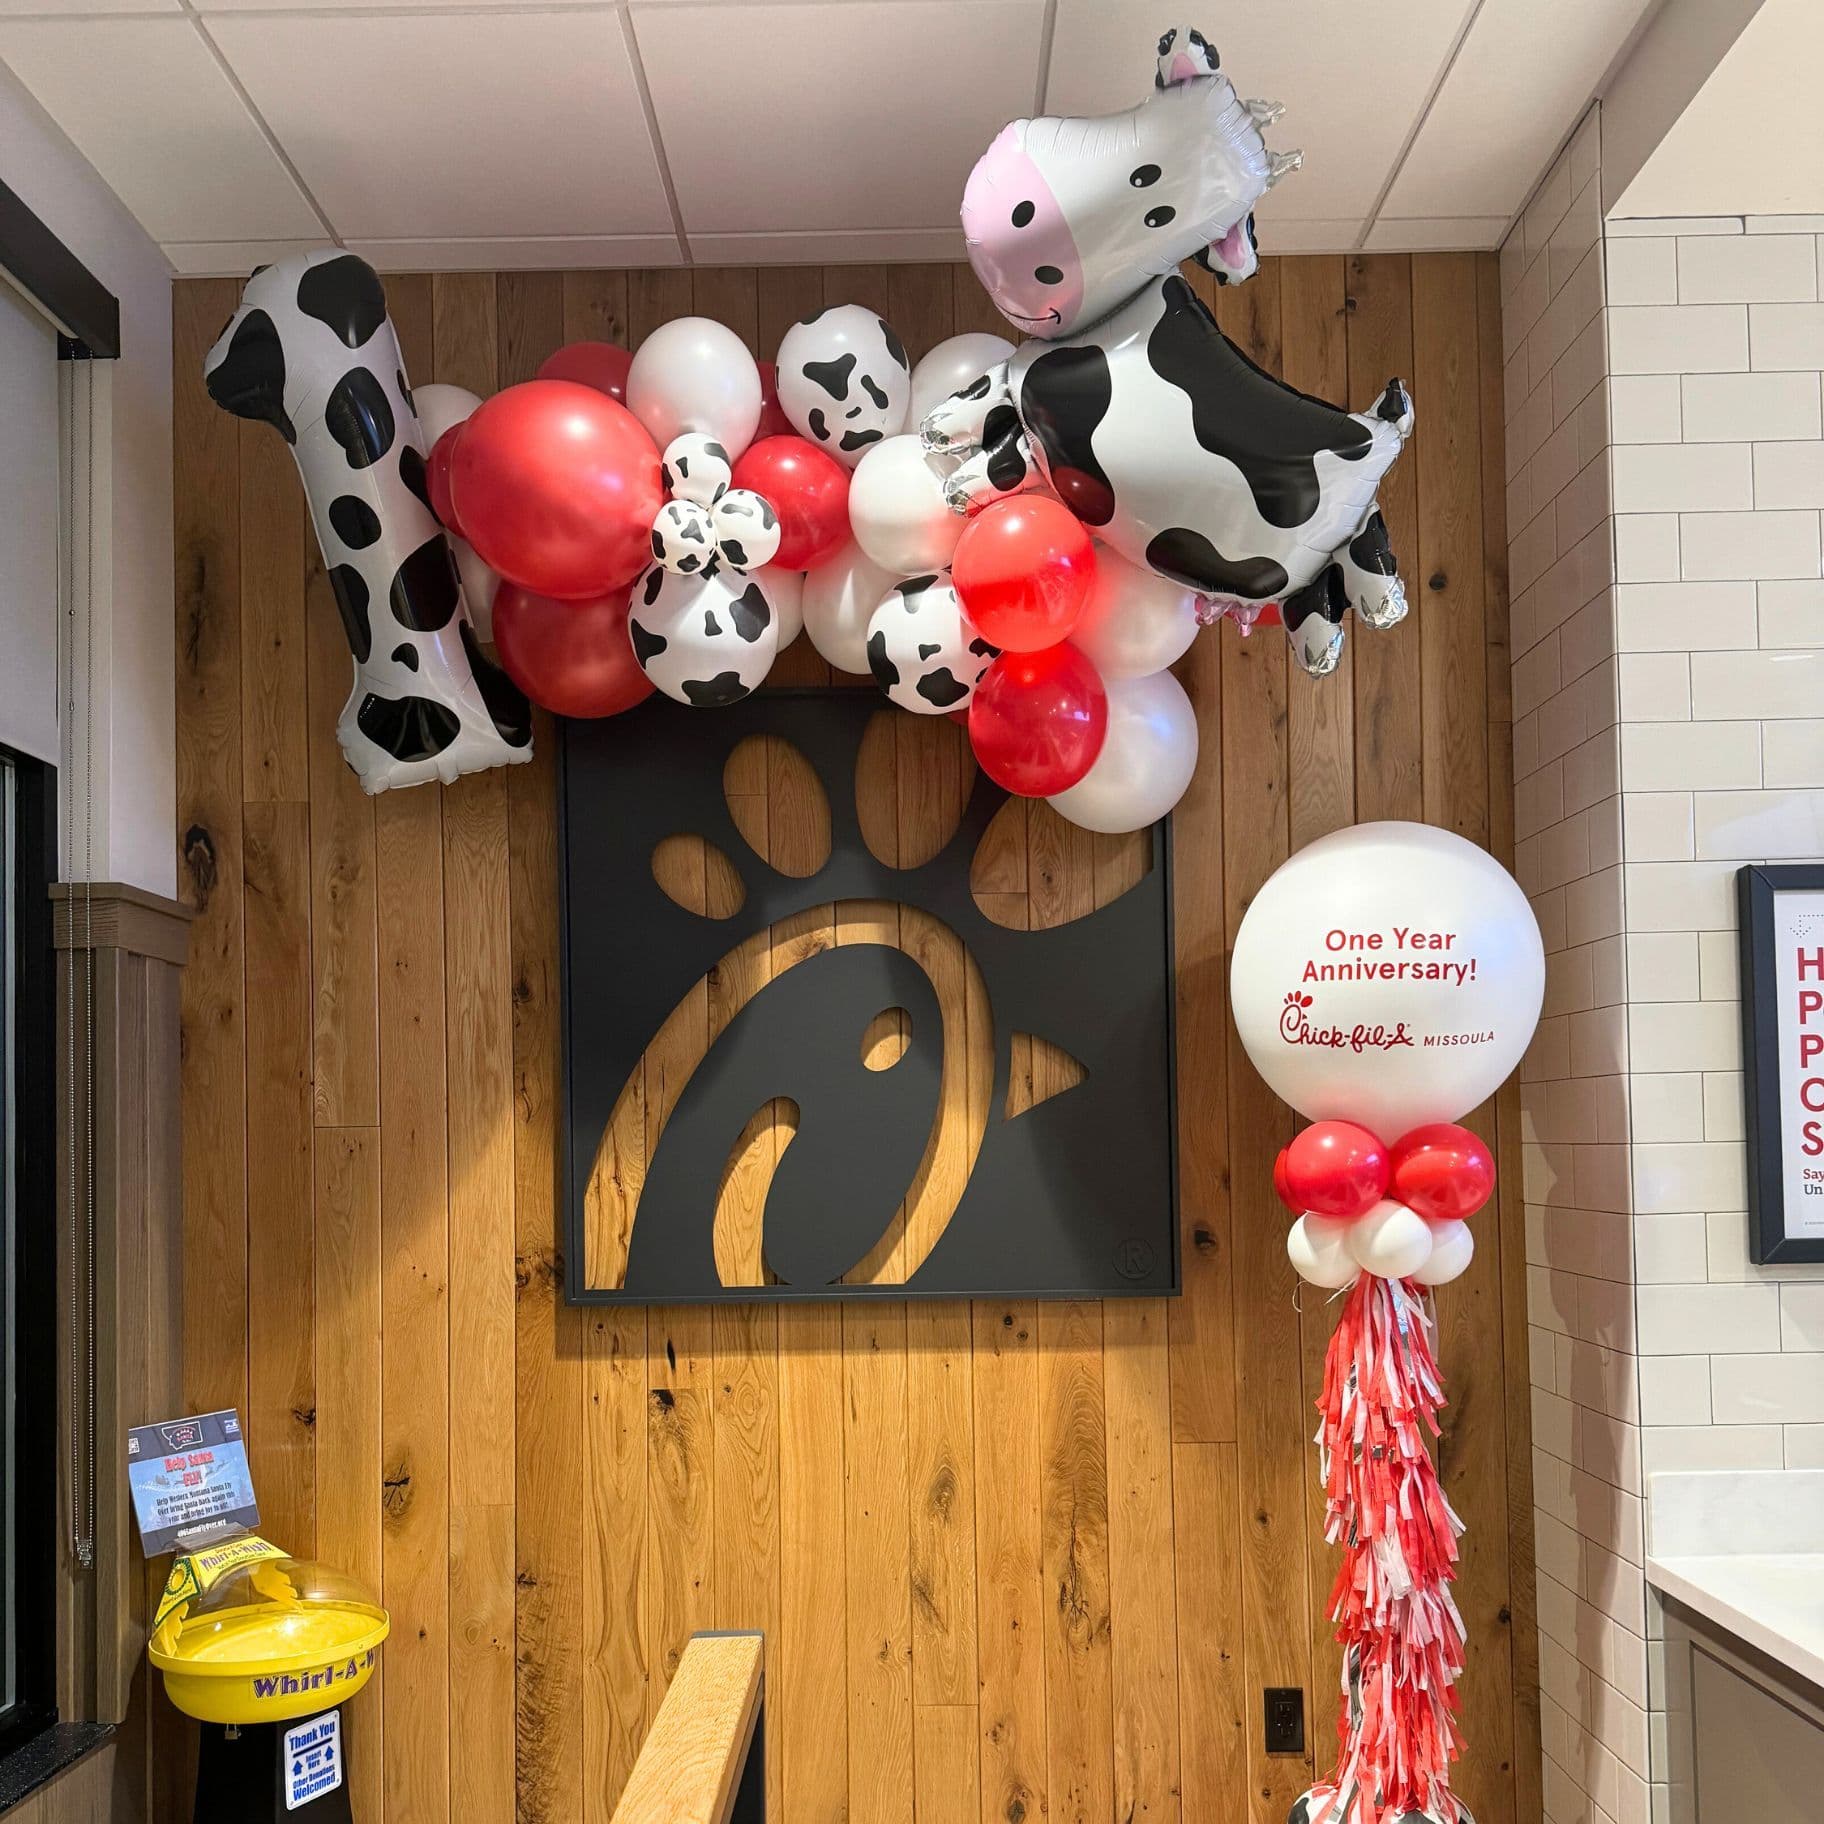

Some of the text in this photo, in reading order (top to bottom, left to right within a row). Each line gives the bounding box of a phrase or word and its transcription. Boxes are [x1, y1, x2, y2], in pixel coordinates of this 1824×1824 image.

[1326, 927, 1456, 951] One Year
[1302, 957, 1477, 986] Anniversary!
[1280, 996, 1495, 1053] Chick-fil-A MISSOULA
[165, 1457, 186, 1472] Help
[156, 1498, 168, 1506] Help
[199, 1497, 210, 1505] back
[211, 1493, 225, 1502] again
[200, 1541, 272, 1571] Whirl-A-Wish
[289, 1721, 335, 1751] Thank You
[306, 1750, 321, 1763] Insert
[308, 1759, 320, 1770] Here
[293, 1764, 335, 1789] Other Donations
[293, 1771, 336, 1801] Welcomed
